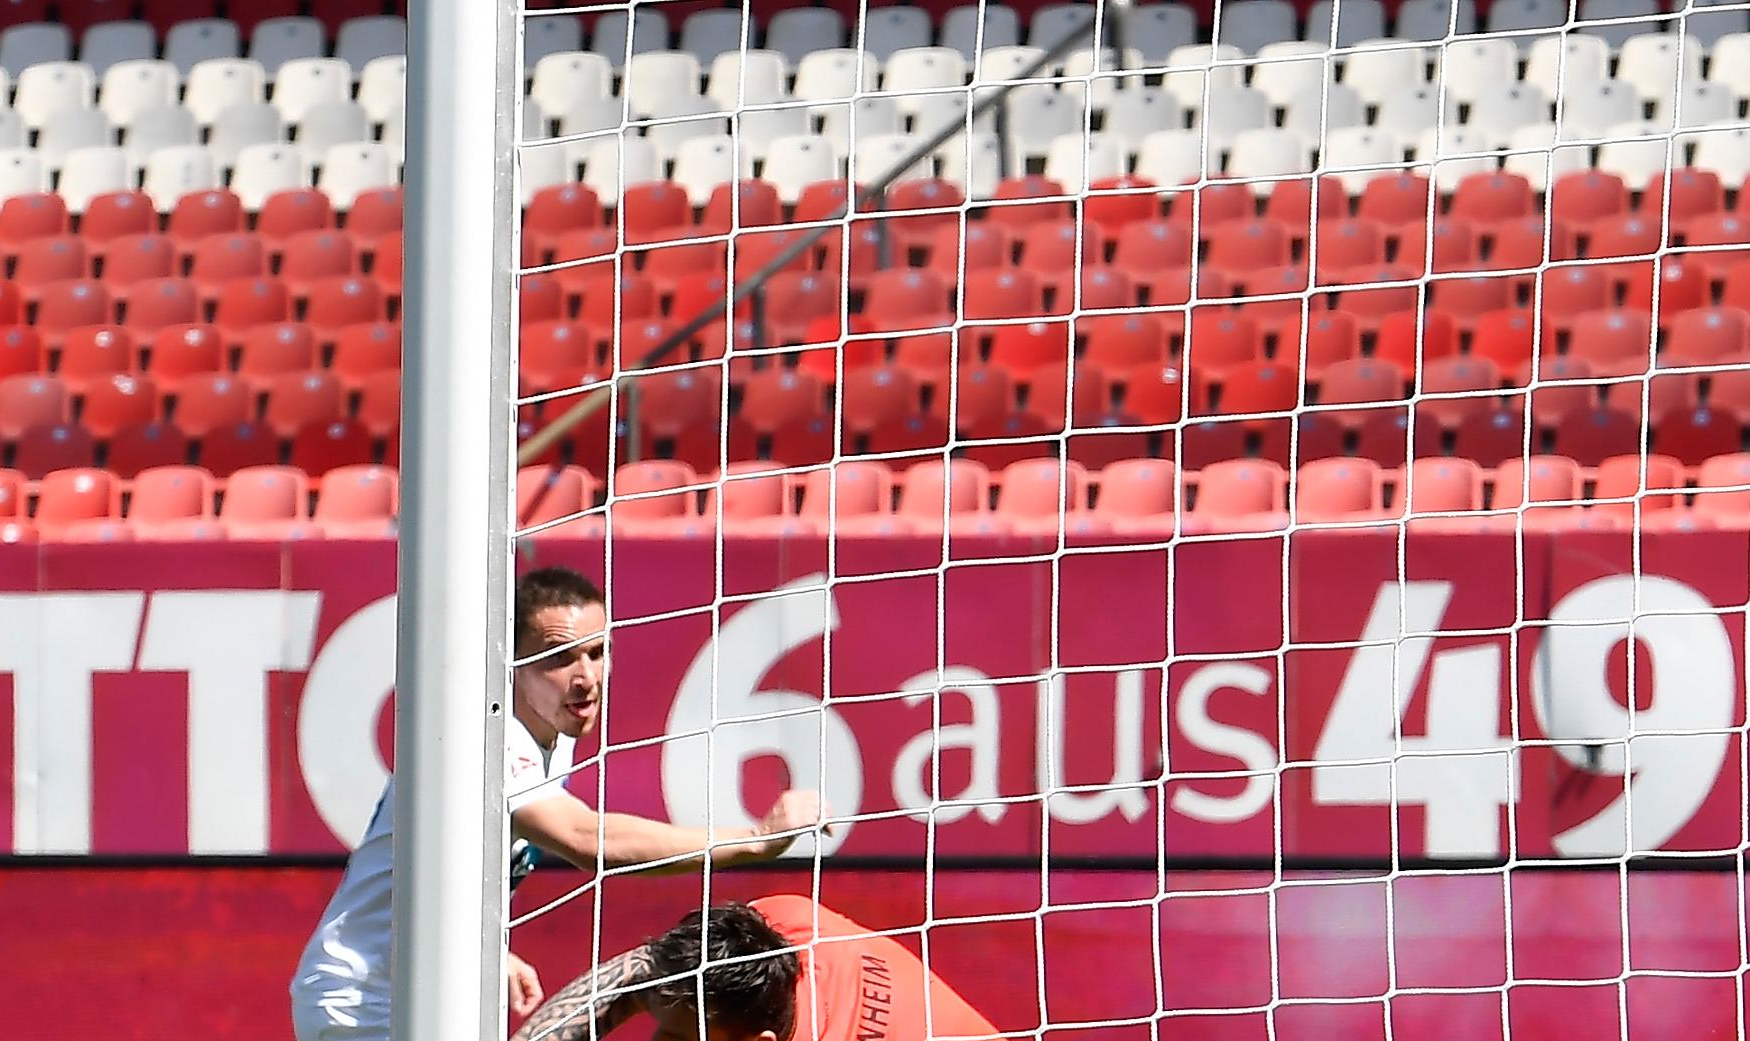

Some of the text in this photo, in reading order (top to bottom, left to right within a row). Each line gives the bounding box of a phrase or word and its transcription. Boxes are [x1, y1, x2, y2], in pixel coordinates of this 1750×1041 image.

[660, 571, 864, 858] 6
[891, 662, 1278, 825] aus
[1312, 573, 1736, 859] 49
